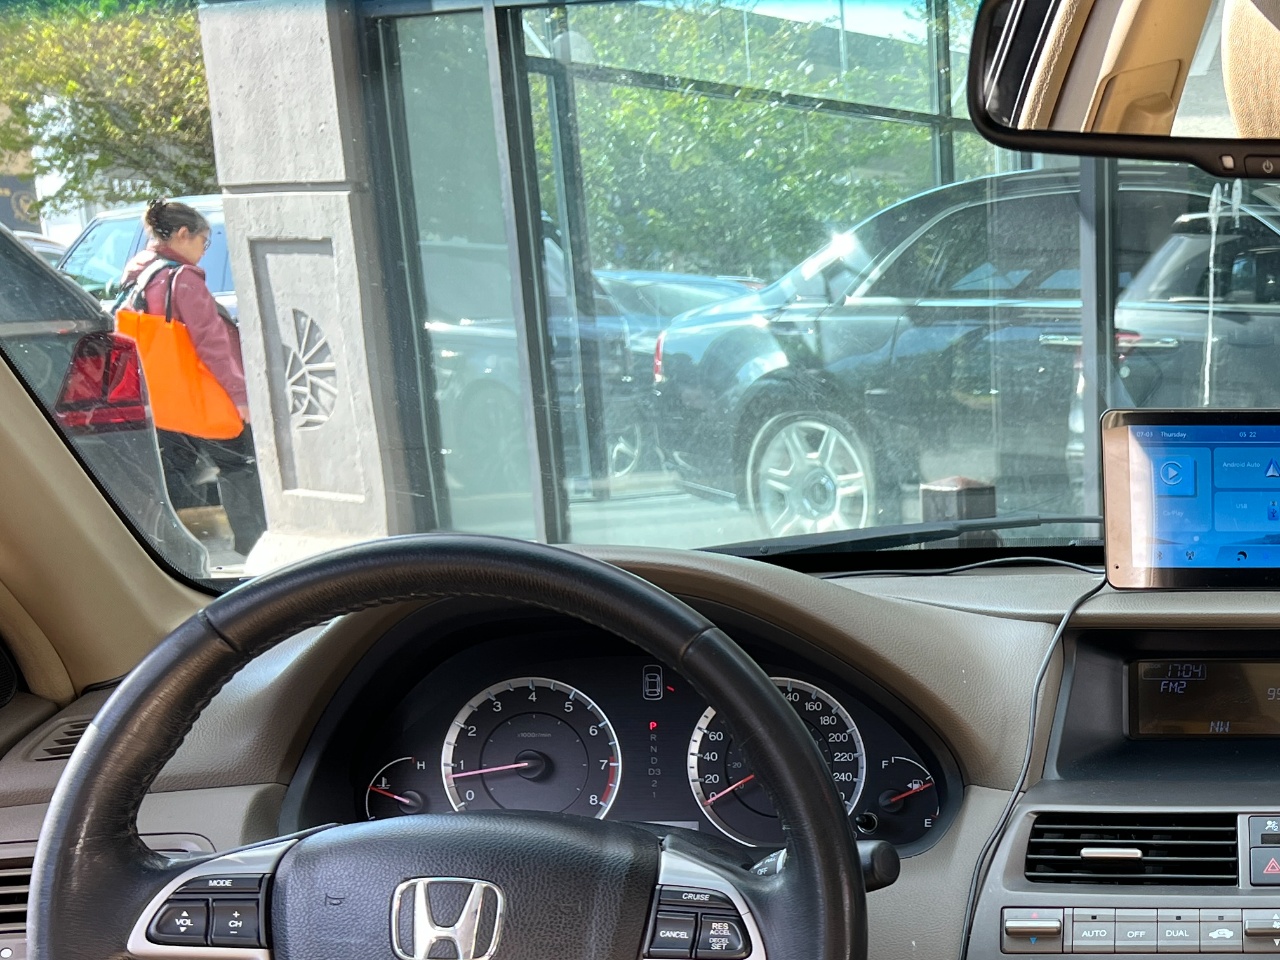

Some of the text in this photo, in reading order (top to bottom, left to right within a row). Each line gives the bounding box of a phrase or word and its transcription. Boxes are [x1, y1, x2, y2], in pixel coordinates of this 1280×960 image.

[1160, 681, 1187, 694] FM2
[528, 692, 537, 702] 4
[493, 702, 502, 712] 3
[564, 702, 573, 712] 5
[805, 702, 822, 711] 160
[820, 716, 837, 725] 180
[650, 722, 657, 730] P
[468, 726, 477, 736] 2
[589, 726, 598, 736] 6
[709, 732, 723, 741] 60
[828, 733, 848, 742] 200
[704, 752, 718, 761] 40
[834, 753, 854, 761] 220
[417, 761, 425, 769] H
[460, 760, 464, 769] 1
[599, 760, 607, 770] 7
[882, 760, 888, 769] F
[705, 774, 719, 784] 20
[833, 773, 853, 781] 240
[465, 790, 475, 801] 0
[589, 795, 598, 805] 8
[924, 819, 932, 828] E
[682, 893, 710, 901] CRUISE
[229, 920, 242, 928] CH
[660, 930, 689, 939] CANCEL
[1127, 930, 1146, 938] OFF
